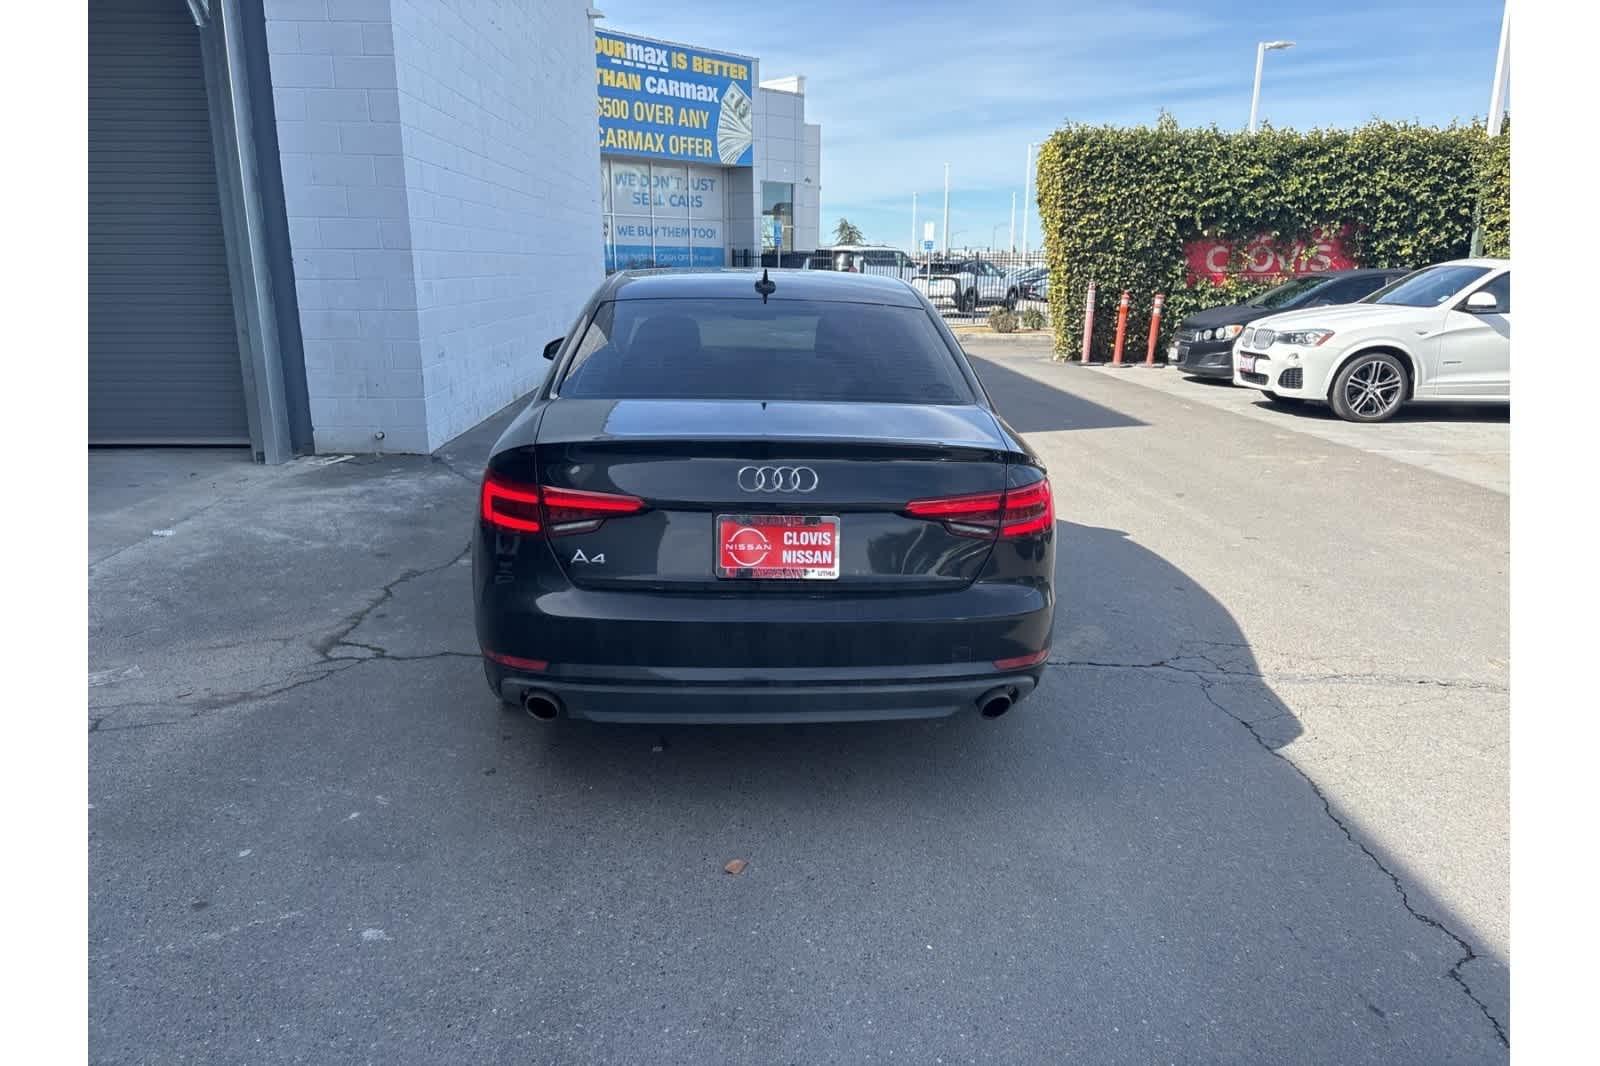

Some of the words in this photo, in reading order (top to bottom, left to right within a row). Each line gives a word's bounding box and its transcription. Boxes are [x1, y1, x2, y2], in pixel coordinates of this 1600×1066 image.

[671, 52, 687, 69] IS
[692, 56, 748, 80] BETTER
[595, 68, 641, 91] THAN
[645, 76, 719, 103] CARmax
[634, 101, 674, 126] OVER
[678, 107, 709, 129] ANY
[669, 135, 712, 157] OFFER
[615, 173, 636, 187] WE
[640, 175, 682, 190] DON'T
[617, 225, 636, 236] WE
[638, 225, 659, 237] BUY
[661, 226, 690, 238] THEM
[783, 531, 831, 545] CLOVIS
[570, 549, 606, 564] A4
[782, 550, 832, 564] NISSAN
